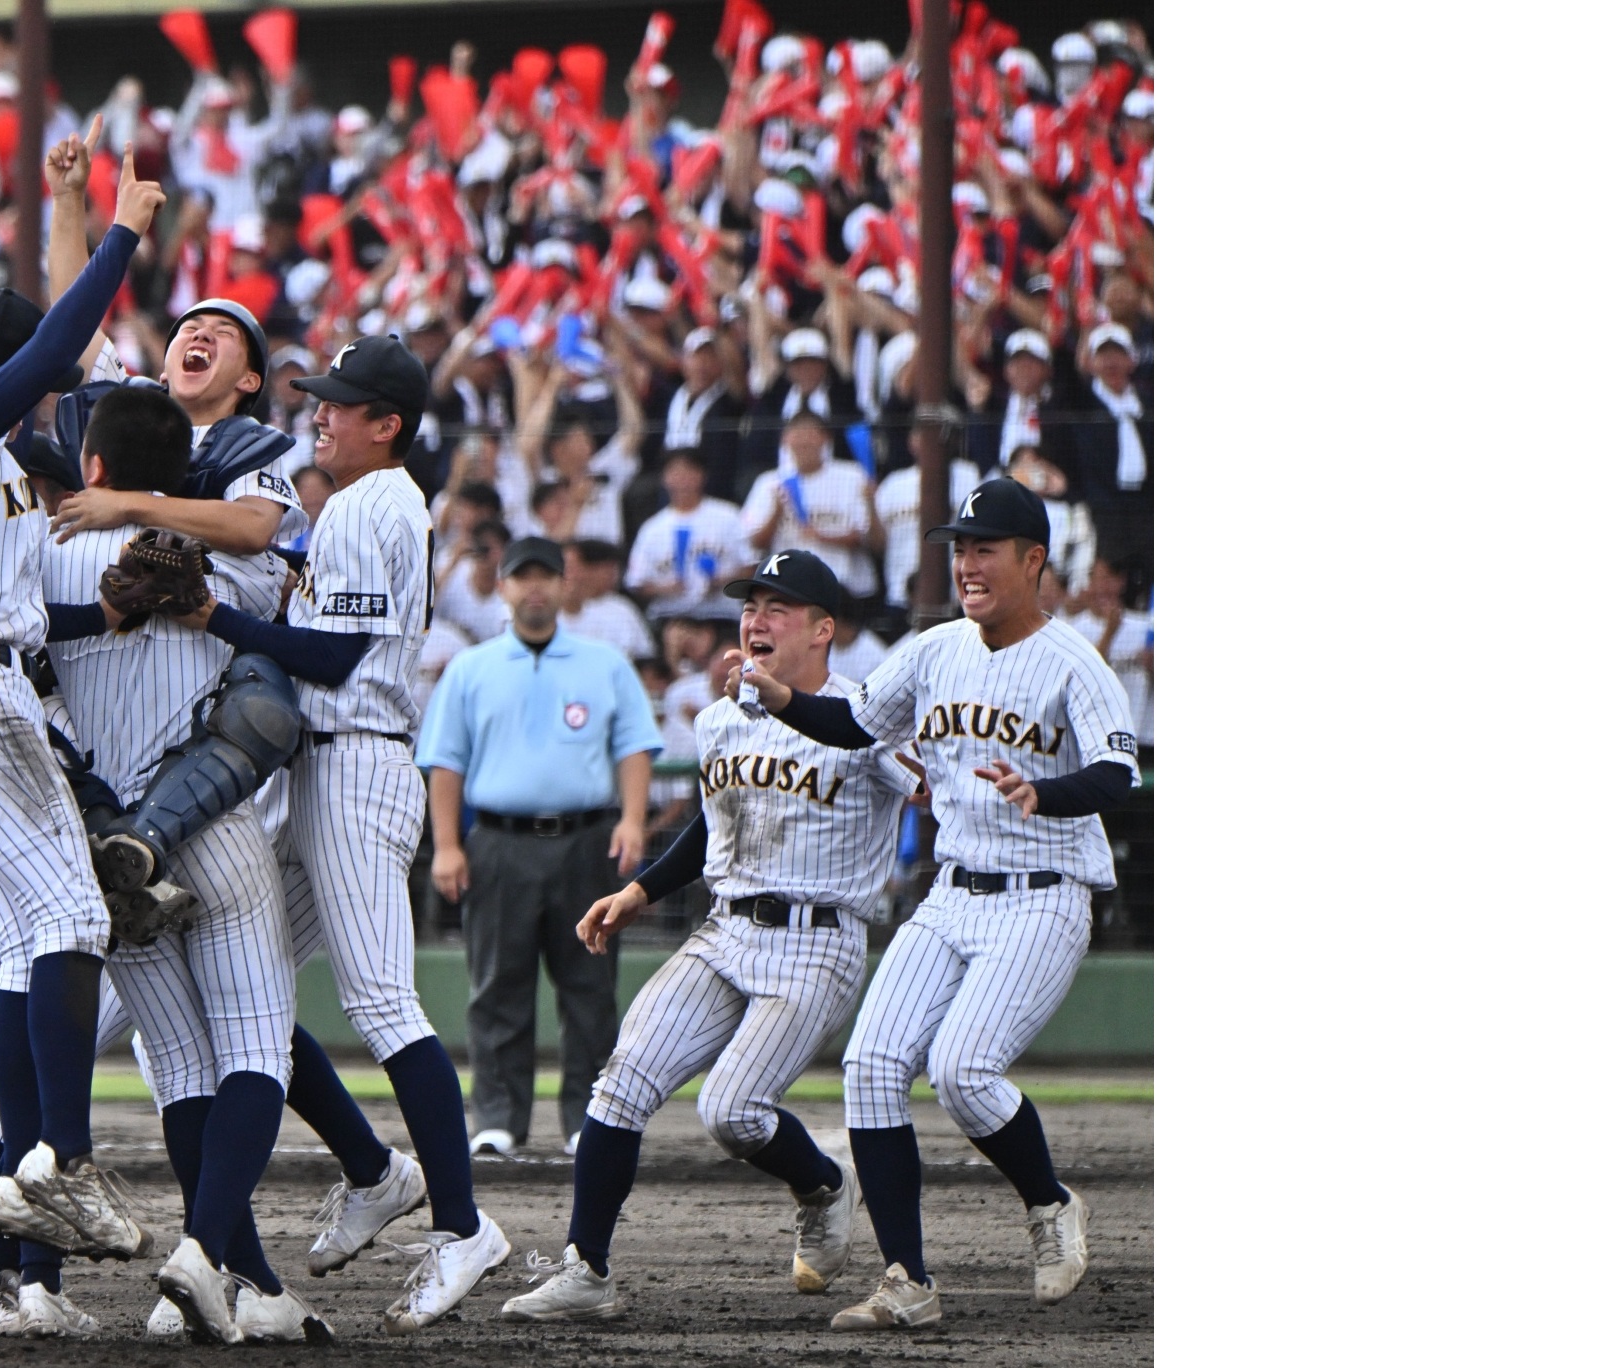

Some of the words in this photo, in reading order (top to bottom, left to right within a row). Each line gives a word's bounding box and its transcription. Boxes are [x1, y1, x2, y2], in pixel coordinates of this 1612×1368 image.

[330, 343, 356, 370] K
[960, 492, 982, 519] K
[762, 554, 790, 576] K
[325, 595, 384, 615] 東日大昌平
